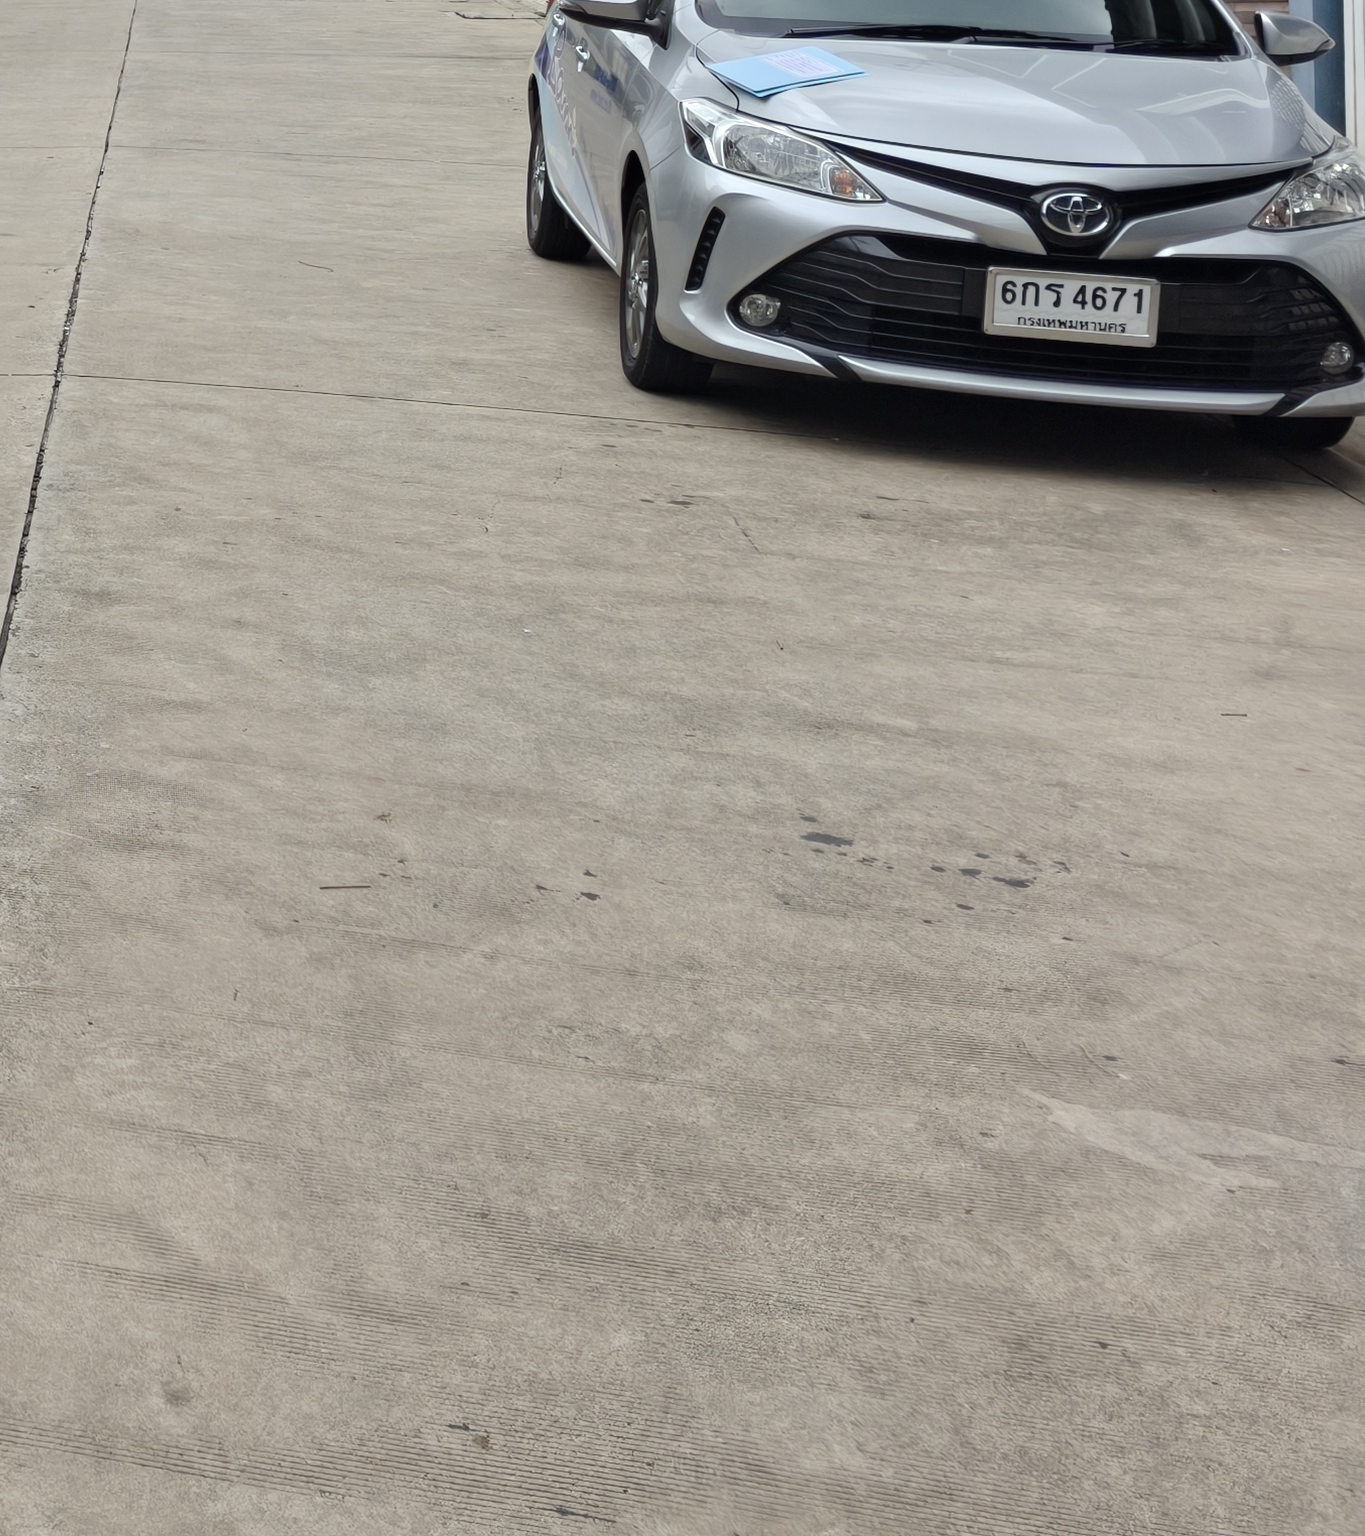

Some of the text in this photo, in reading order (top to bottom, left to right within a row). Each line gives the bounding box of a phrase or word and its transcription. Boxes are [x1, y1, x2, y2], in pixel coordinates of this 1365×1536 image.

[1001, 280, 1145, 315] 6กร 4671
[1017, 316, 1128, 334] กรงเทพมหานคร
